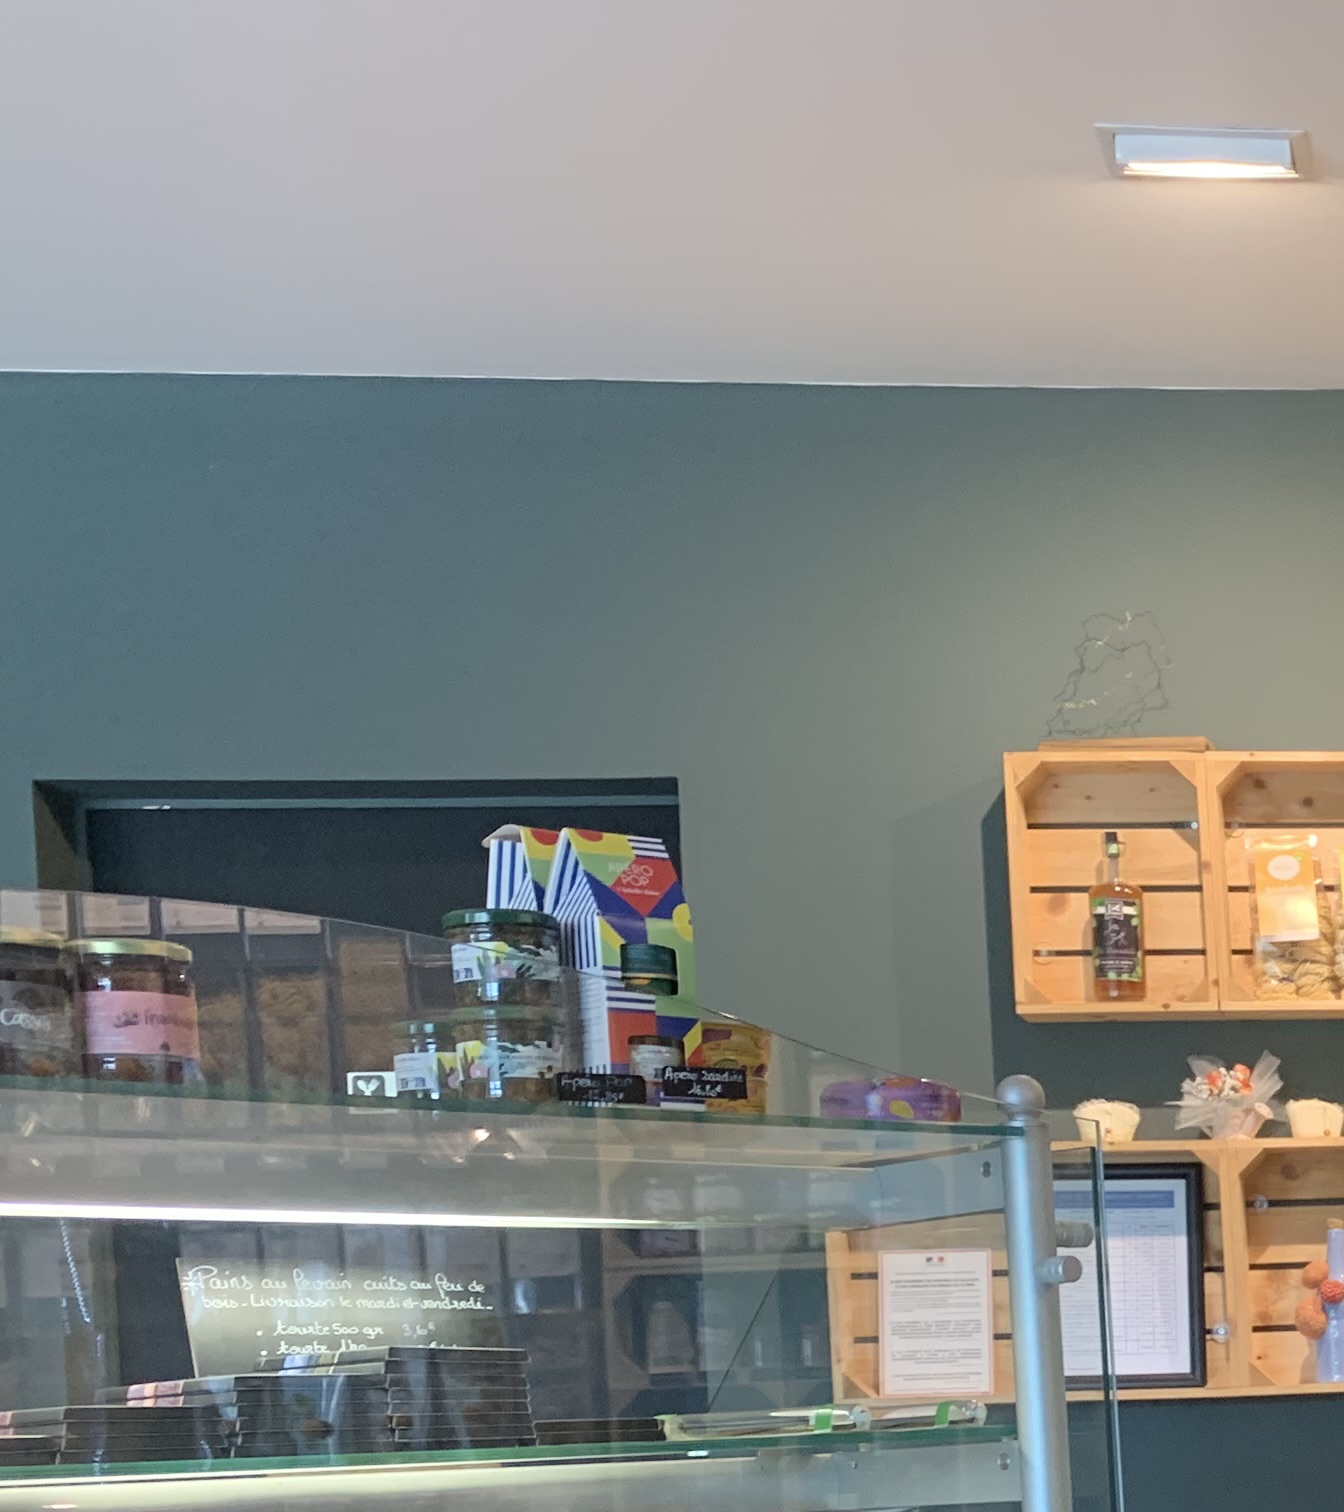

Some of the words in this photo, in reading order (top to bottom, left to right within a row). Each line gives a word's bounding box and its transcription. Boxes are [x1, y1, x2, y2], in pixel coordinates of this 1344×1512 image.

[193, 1265, 252, 1290] Pains
[261, 1277, 287, 1290] au
[410, 1279, 432, 1291] au
[468, 1279, 485, 1293] de
[273, 1320, 330, 1337] tourte
[363, 1325, 385, 1342] gr
